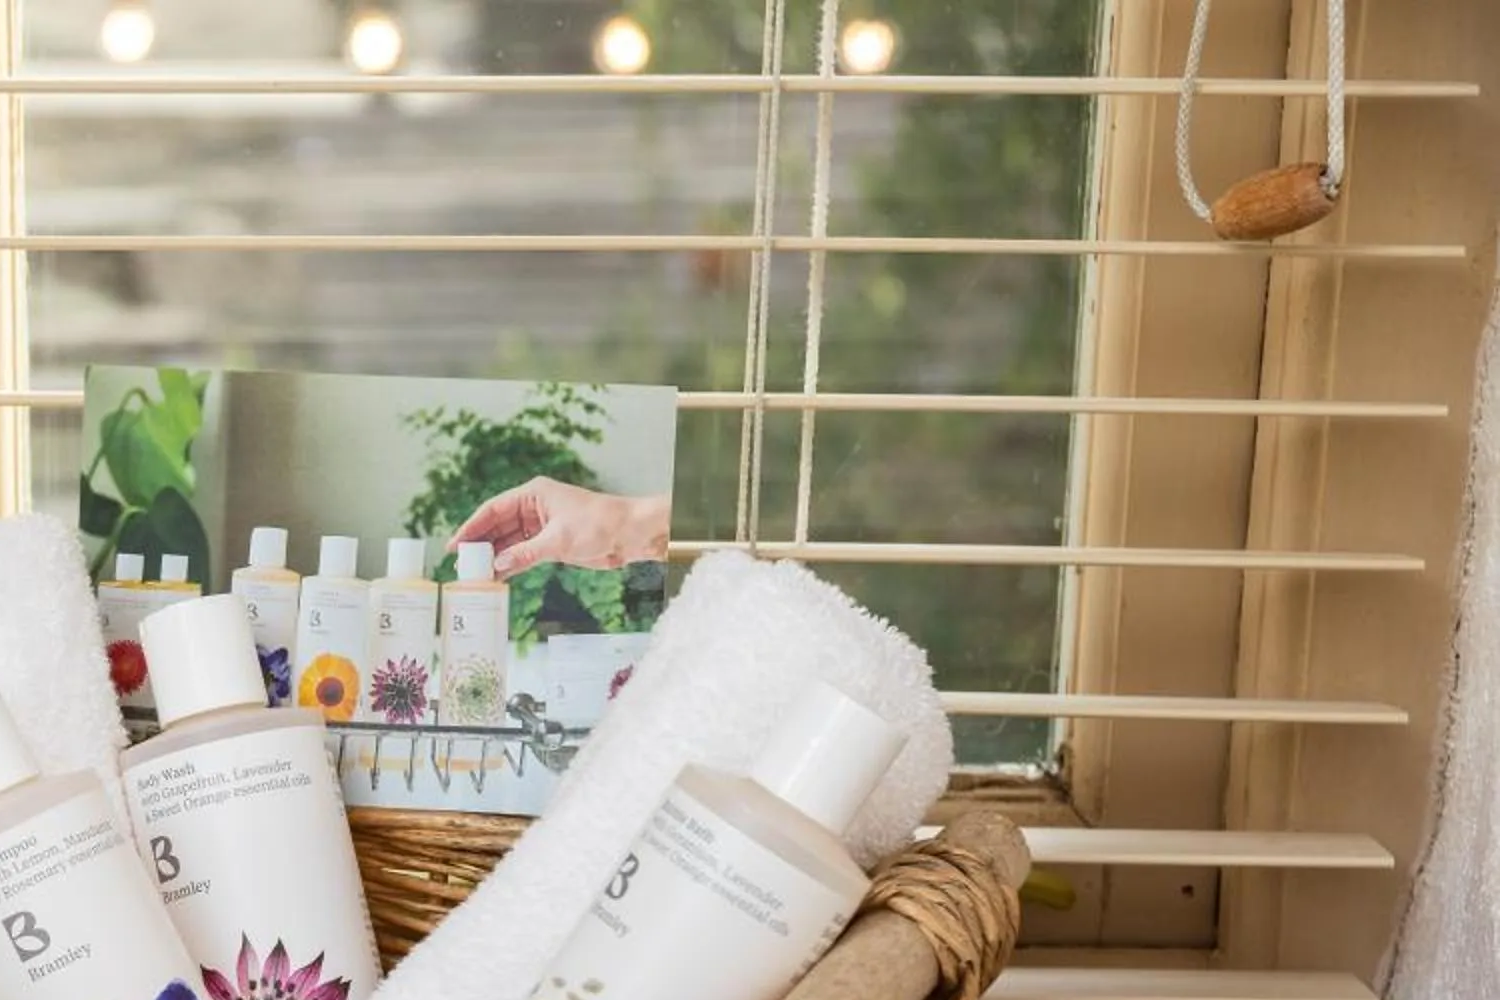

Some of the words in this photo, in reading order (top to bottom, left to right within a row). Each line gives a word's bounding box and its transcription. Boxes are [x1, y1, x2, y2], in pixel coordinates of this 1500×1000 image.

[160, 761, 196, 784] Wash
[233, 757, 293, 780] Lavender
[1, 860, 68, 900] Rosemary
[150, 835, 181, 885] B
[161, 879, 212, 906] Bramley
[1, 910, 51, 963] B
[26, 941, 92, 983] Bramley
